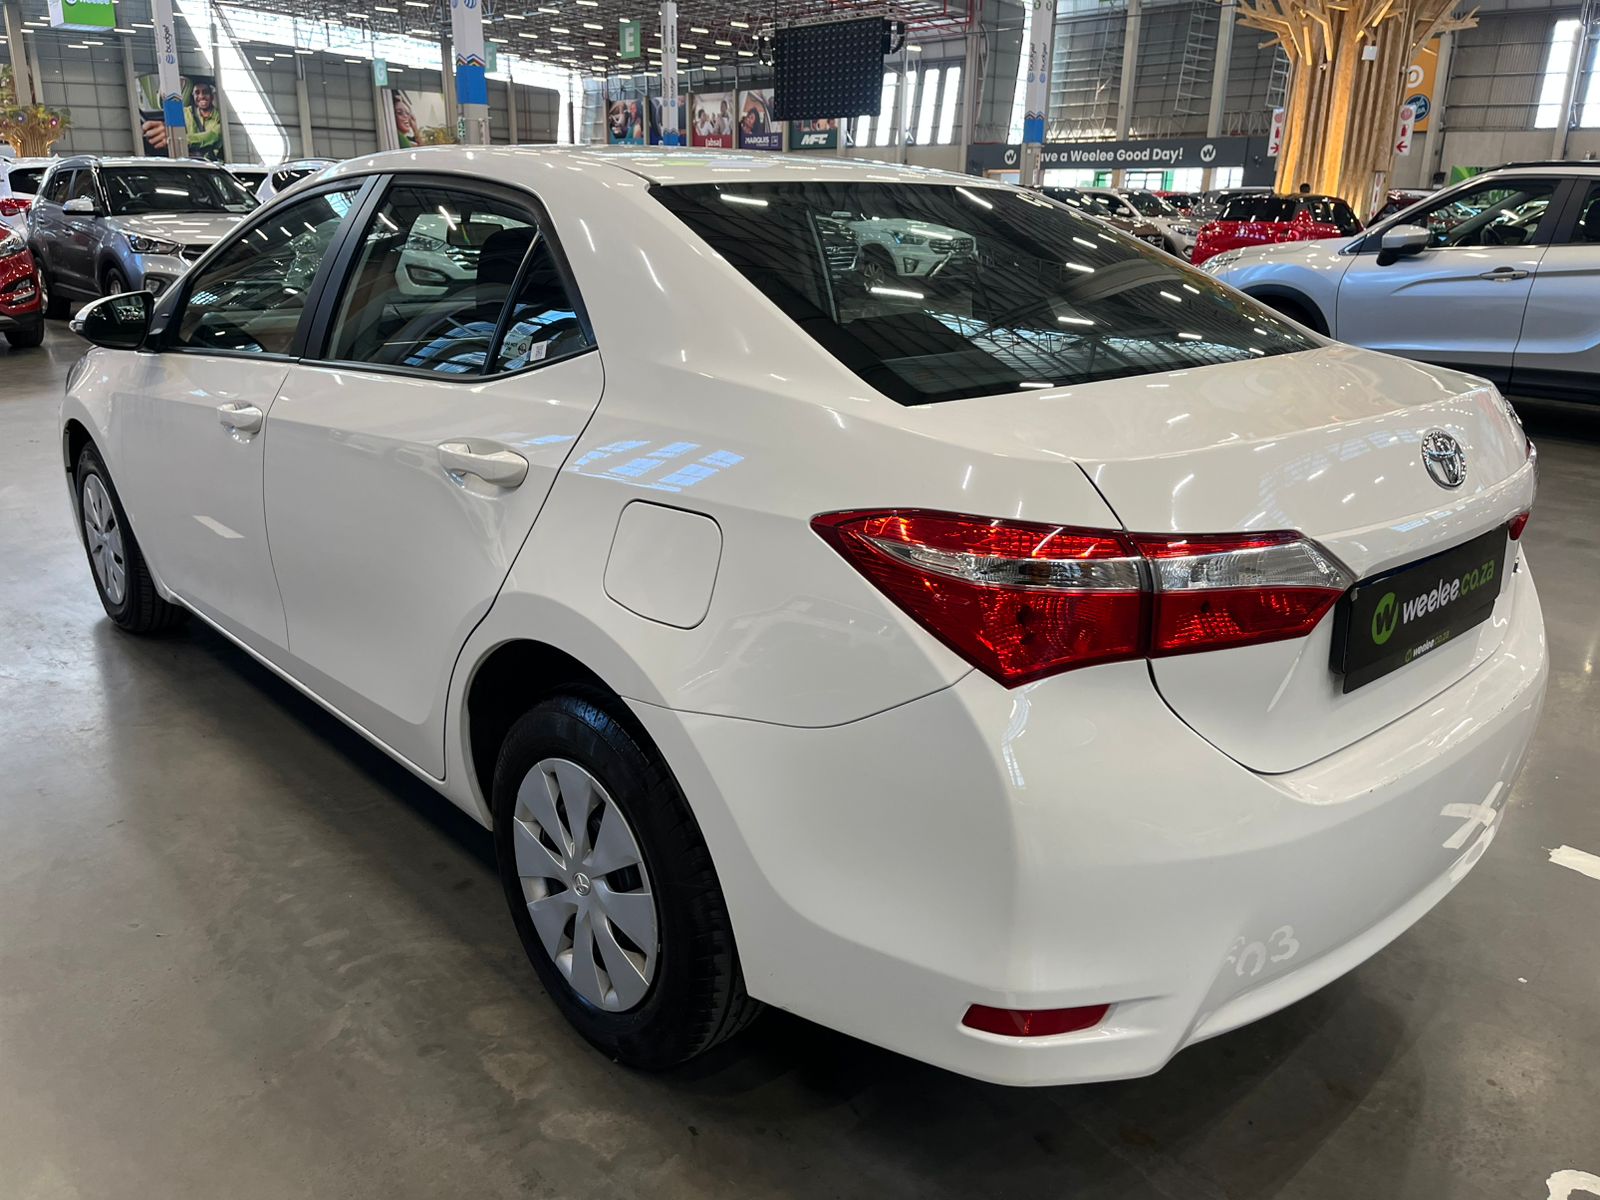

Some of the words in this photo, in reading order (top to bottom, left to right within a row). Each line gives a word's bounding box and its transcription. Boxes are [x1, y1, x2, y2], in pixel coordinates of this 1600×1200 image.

[162, 25, 173, 53] budget
[624, 26, 635, 53] E
[744, 135, 770, 145] MARQUIS
[800, 133, 829, 146] MFC
[1060, 152, 1069, 162] a
[1070, 149, 1115, 163] Weelee
[1116, 148, 1150, 161] Good
[1152, 147, 1184, 165] Day!
